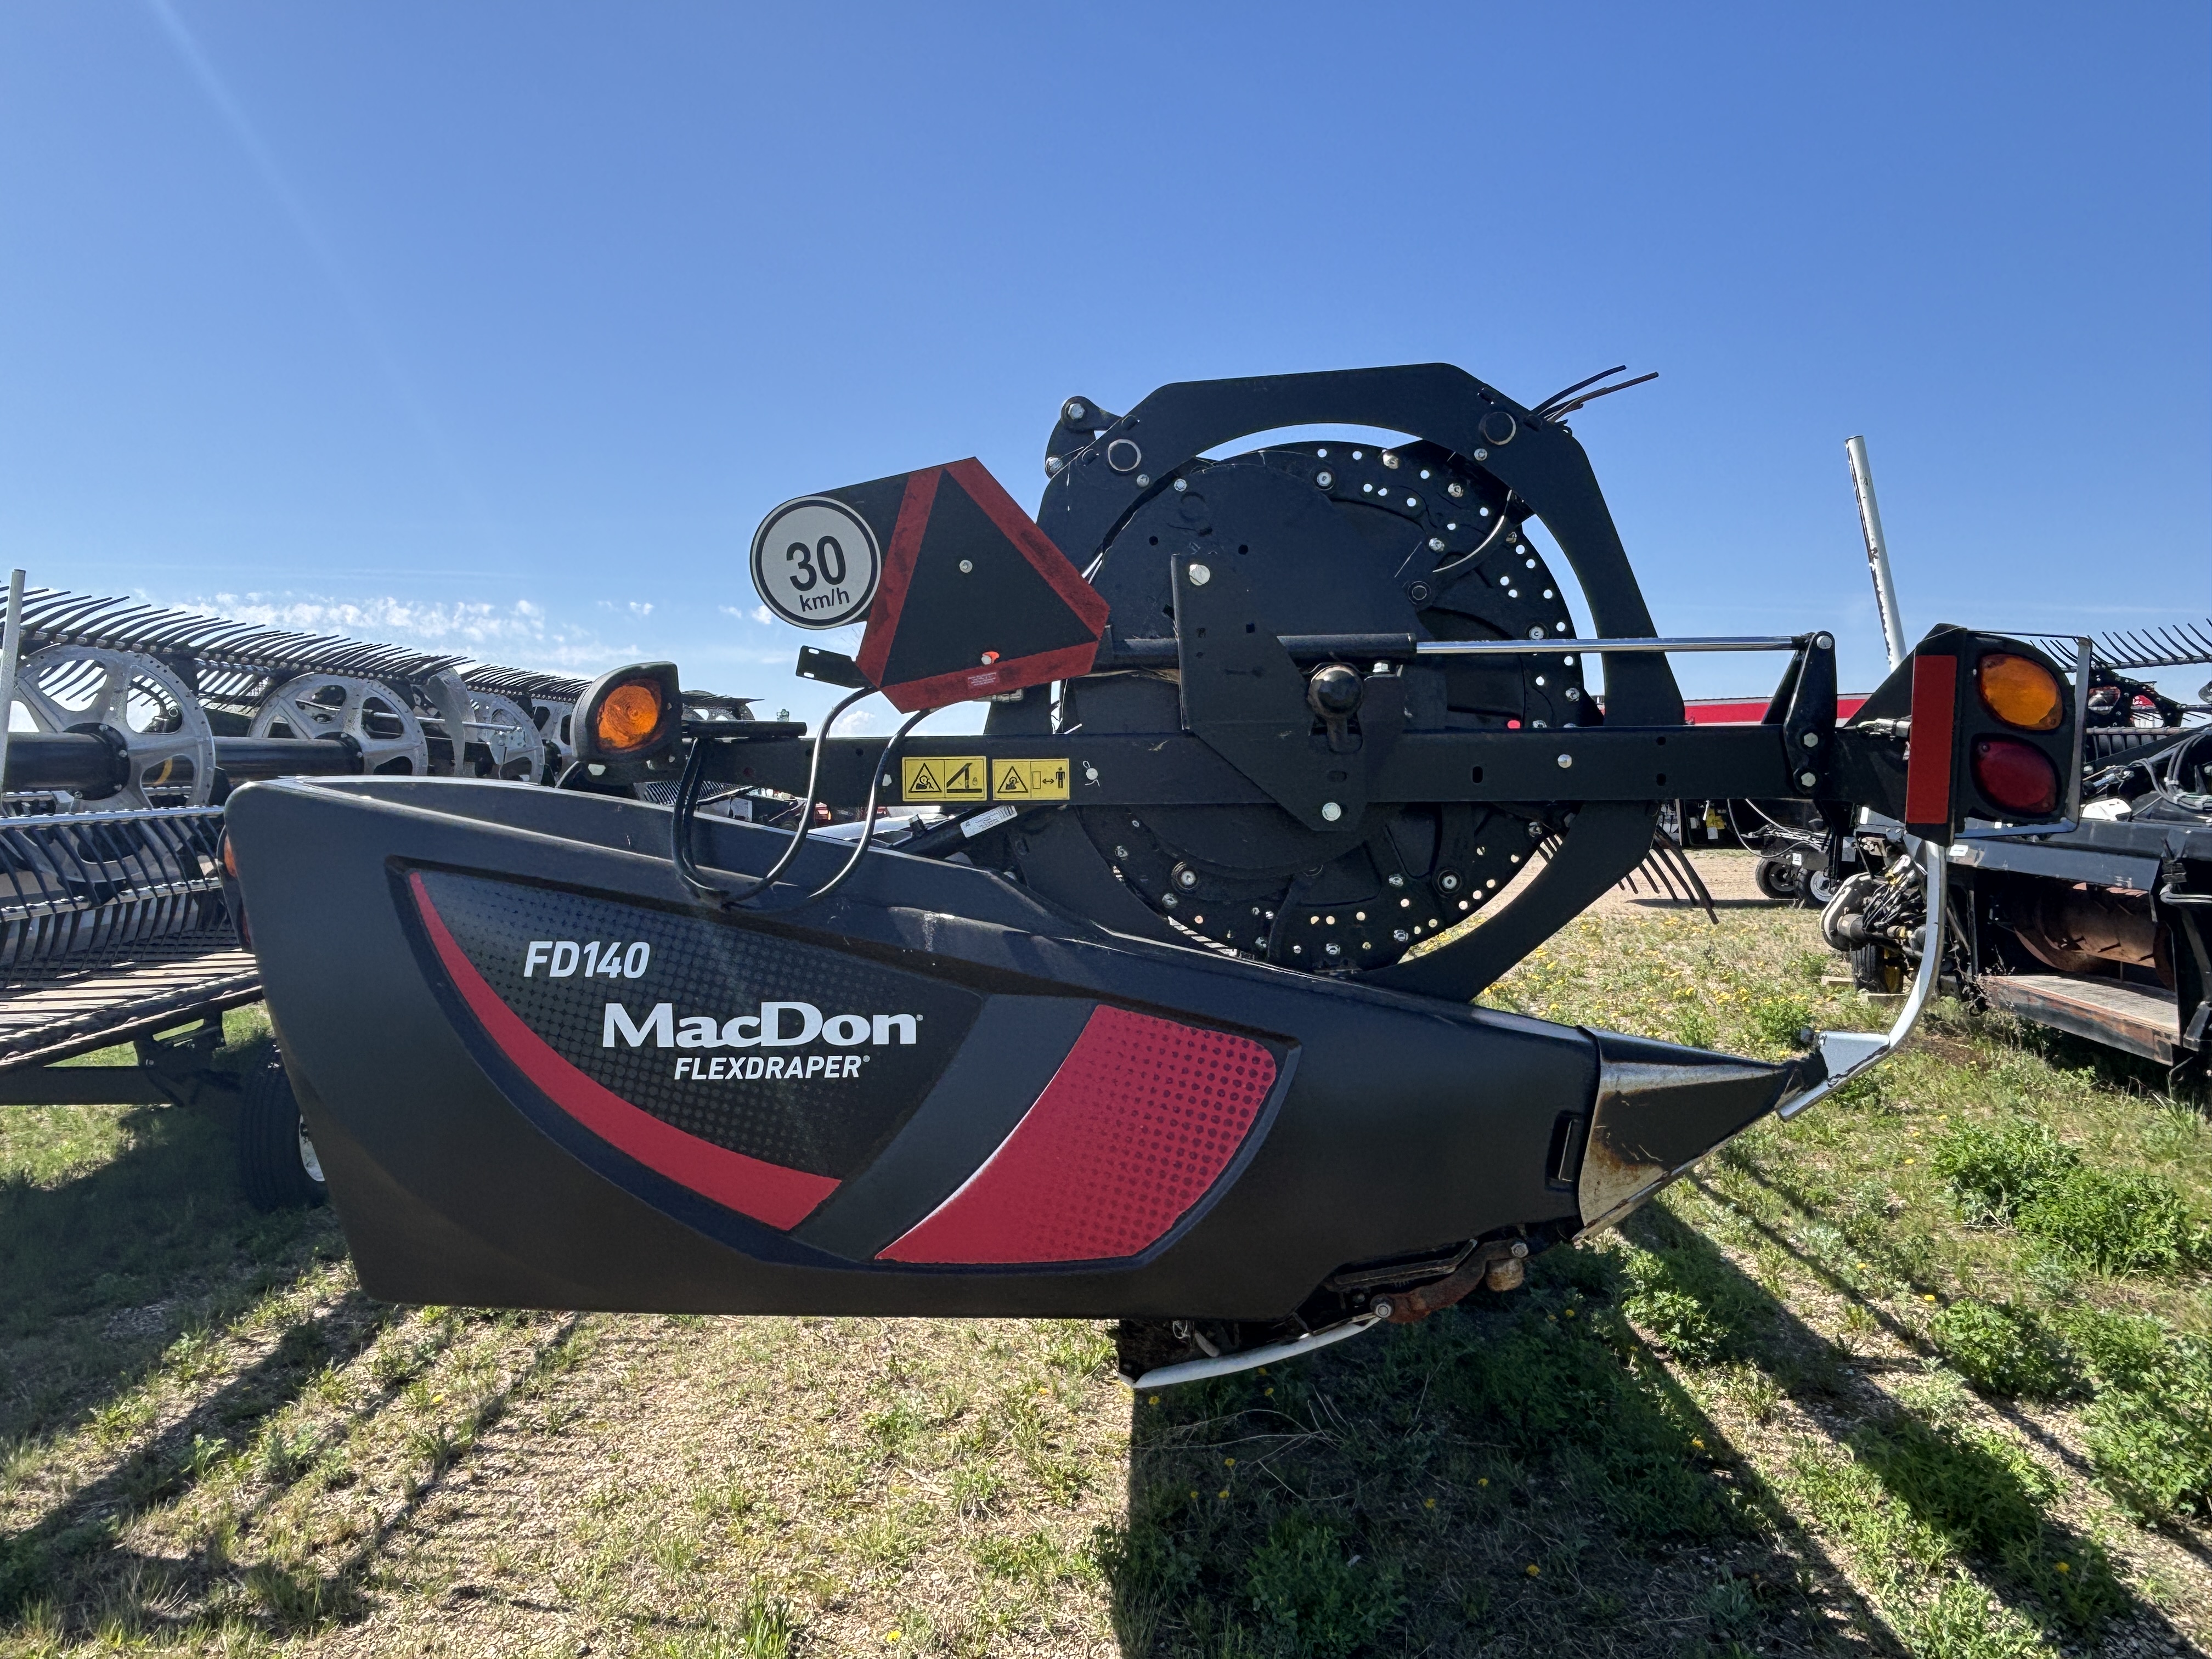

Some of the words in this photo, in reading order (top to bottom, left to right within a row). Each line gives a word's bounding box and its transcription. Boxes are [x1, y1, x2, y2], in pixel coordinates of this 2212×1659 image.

[786, 535, 847, 591] 30
[799, 587, 850, 612] km/h
[523, 941, 650, 979] FD140
[602, 1001, 917, 1048] MacDon
[674, 1055, 862, 1080] FLEXDRAPER
